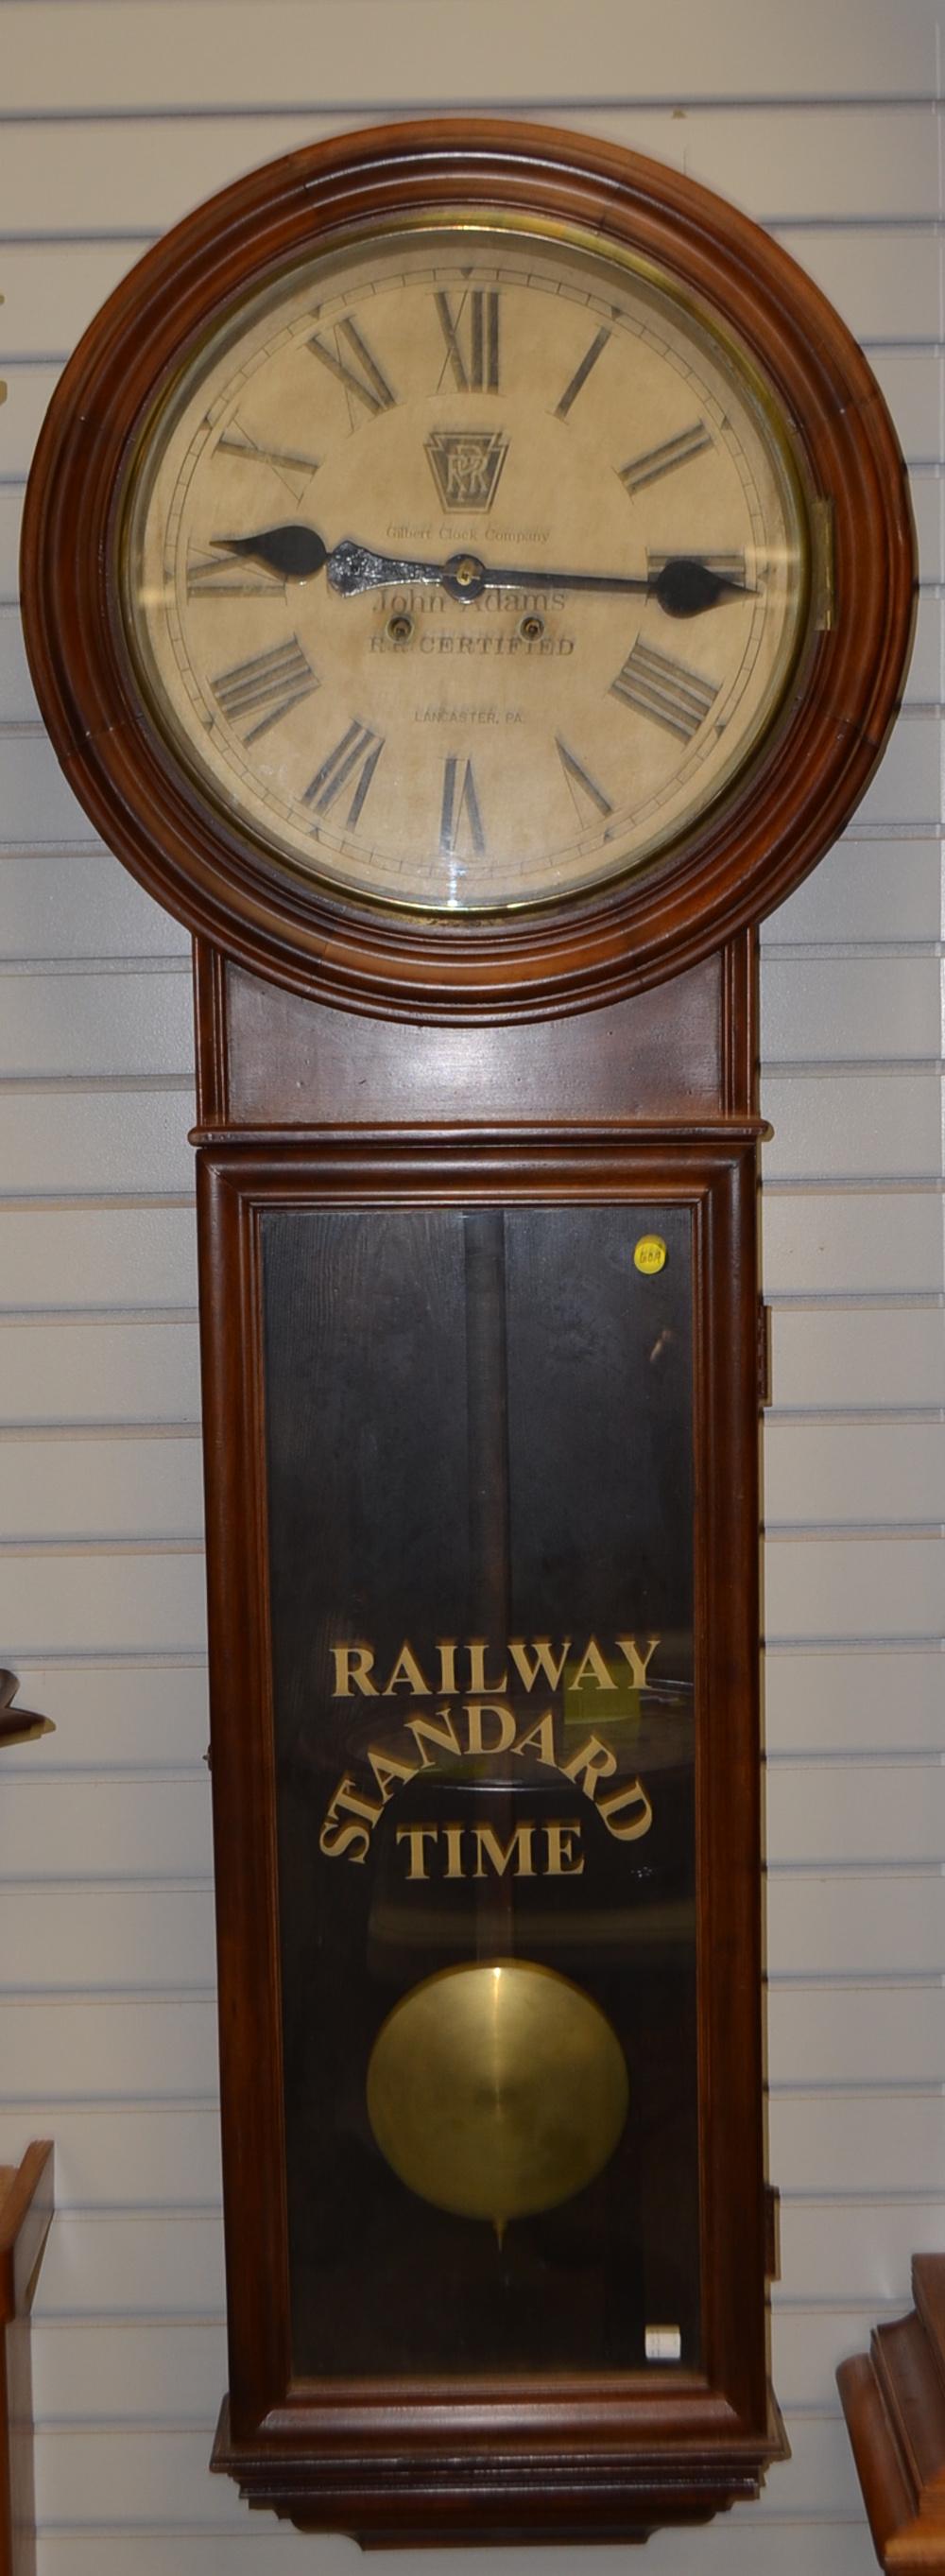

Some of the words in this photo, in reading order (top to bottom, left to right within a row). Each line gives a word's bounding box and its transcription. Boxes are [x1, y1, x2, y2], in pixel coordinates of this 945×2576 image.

[304, 312, 404, 437] XI
[434, 290, 504, 395] XII
[211, 406, 323, 507] X
[617, 417, 718, 505] II
[386, 526, 431, 541] Gilbert
[438, 527, 476, 541] Clock
[485, 528, 550, 545] Company
[372, 589, 445, 614] John
[460, 589, 565, 614] Adams
[420, 636, 575, 657] CERTIFIED
[437, 756, 487, 853] VI
[330, 1640, 661, 1697] RAILWAY
[319, 1704, 655, 1864] STANDARD
[396, 1825, 586, 1879] TIME
